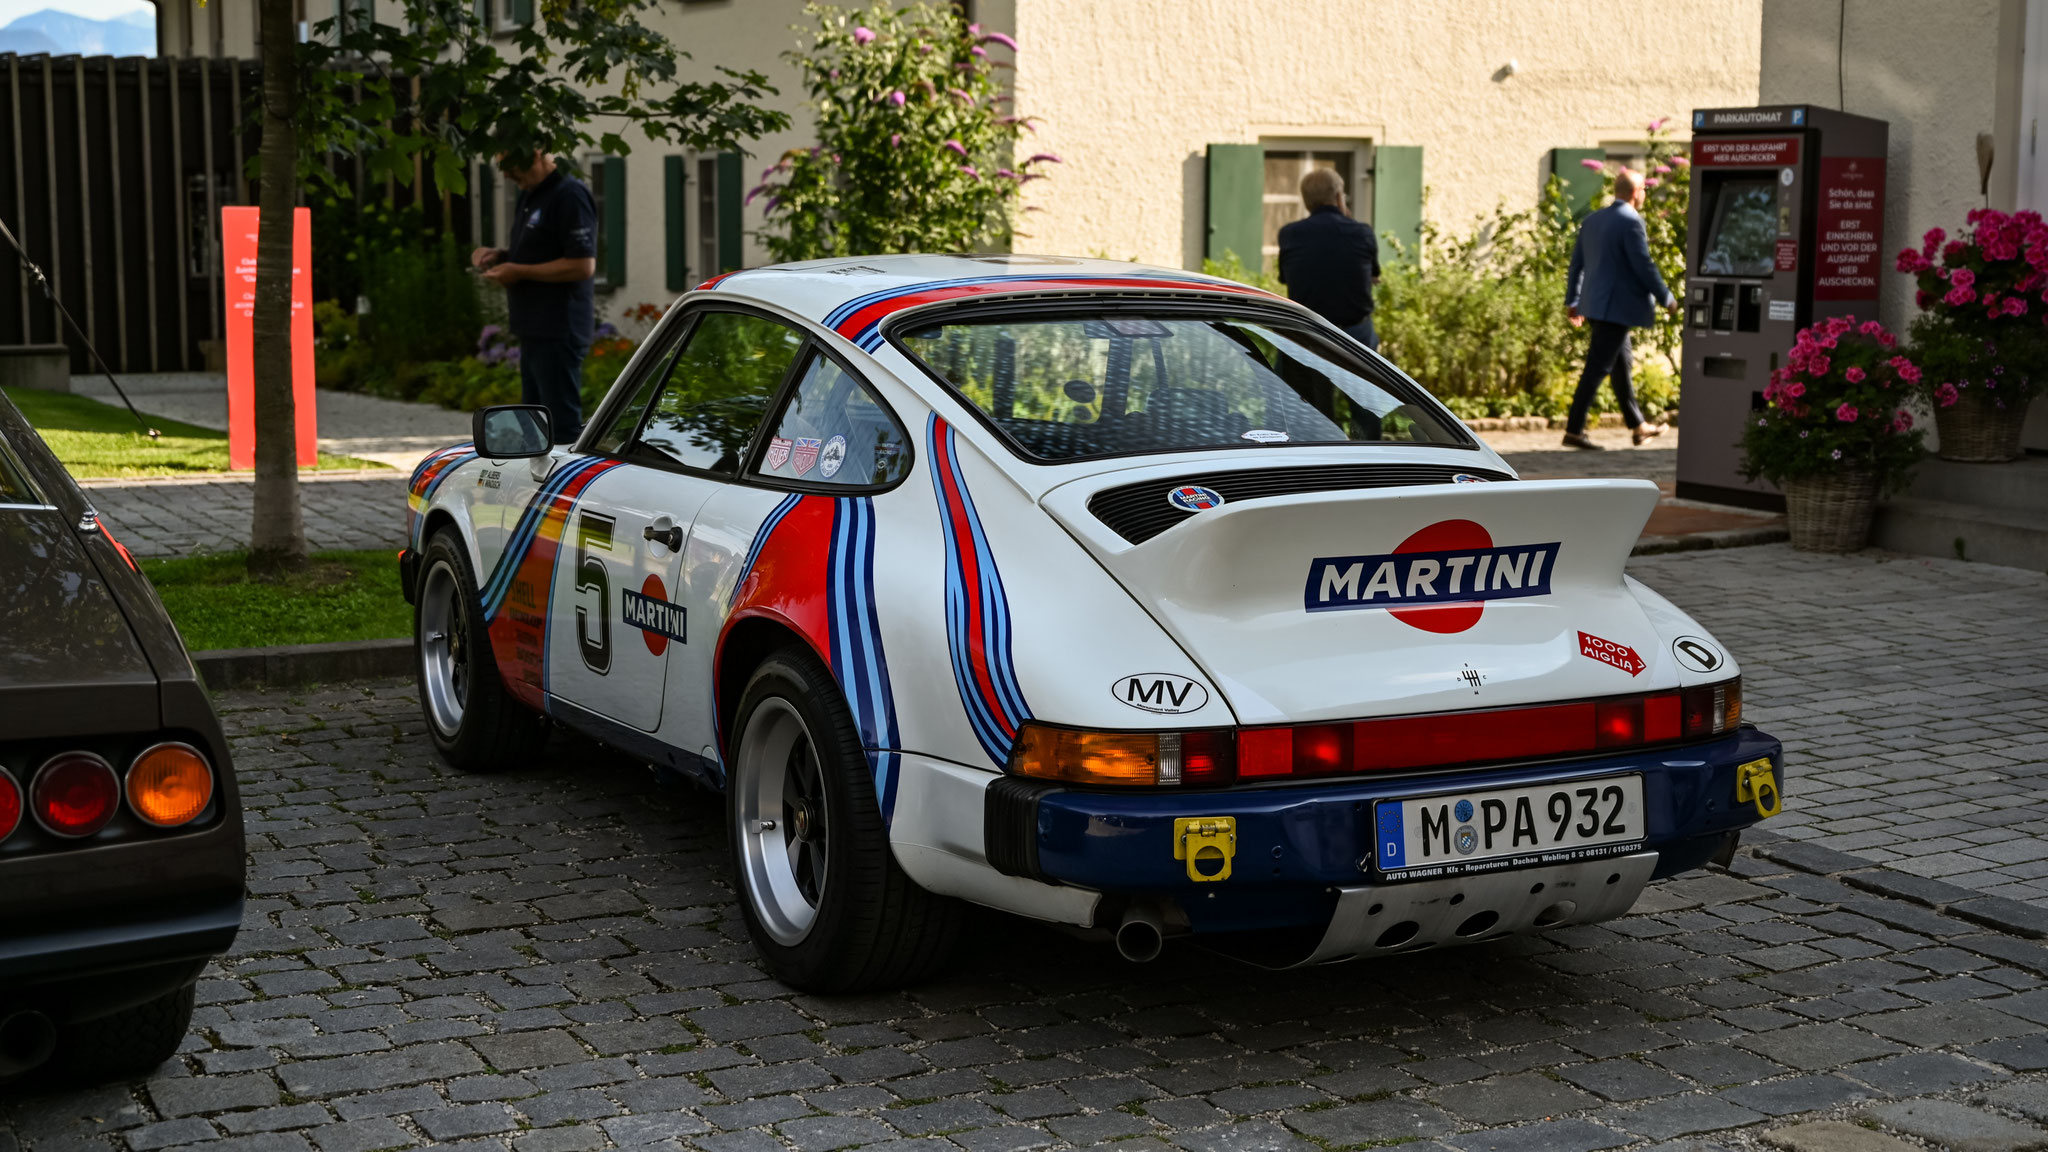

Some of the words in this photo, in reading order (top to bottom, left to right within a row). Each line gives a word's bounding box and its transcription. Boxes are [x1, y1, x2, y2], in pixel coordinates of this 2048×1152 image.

[1714, 112, 1782, 123] PARKAUTOMAT
[1703, 144, 1719, 152] ERST
[1721, 143, 1734, 152] VOR
[1736, 143, 1750, 151] DER
[1752, 142, 1787, 151] AUSFAHRT
[1714, 154, 1730, 162] HIER
[1731, 153, 1776, 162] AUSCHECKEN
[1828, 188, 1855, 199] Schön,
[1857, 188, 1875, 198] dass
[1829, 200, 1841, 209] Sie
[1843, 200, 1853, 209] da
[1855, 200, 1873, 209] sind.
[1840, 220, 1861, 229] ERST
[1826, 231, 1873, 241] EINKEHREN
[1821, 243, 1840, 252] UND
[1841, 243, 1859, 252] VOR
[1860, 243, 1877, 252] DER
[1827, 254, 1870, 263] AUSFAHRT
[1839, 265, 1858, 274] HIER
[1319, 551, 1547, 602] MARTINI
[511, 580, 536, 609] SHELL
[575, 508, 616, 676] 5
[509, 607, 543, 629] DUNLOP
[625, 593, 684, 637] MARTINI
[1585, 636, 1628, 657] 1000
[1676, 640, 1717, 670] D
[1584, 646, 1633, 671] MIGLIA
[1128, 678, 1193, 707] MV
[1421, 804, 1450, 857] M
[1481, 796, 1538, 849] PA
[1547, 785, 1626, 841] 932
[1387, 842, 1396, 857] D
[1386, 871, 1407, 880] AUTO
[1409, 867, 1443, 878] WAGNER
[1446, 866, 1459, 874] Kfz
[1465, 861, 1509, 872] Reparaturen
[1513, 857, 1538, 866] Dachau
[1542, 853, 1569, 862] Webling
[1585, 848, 1607, 857] 08131
[1612, 844, 1642, 853] 6150375
